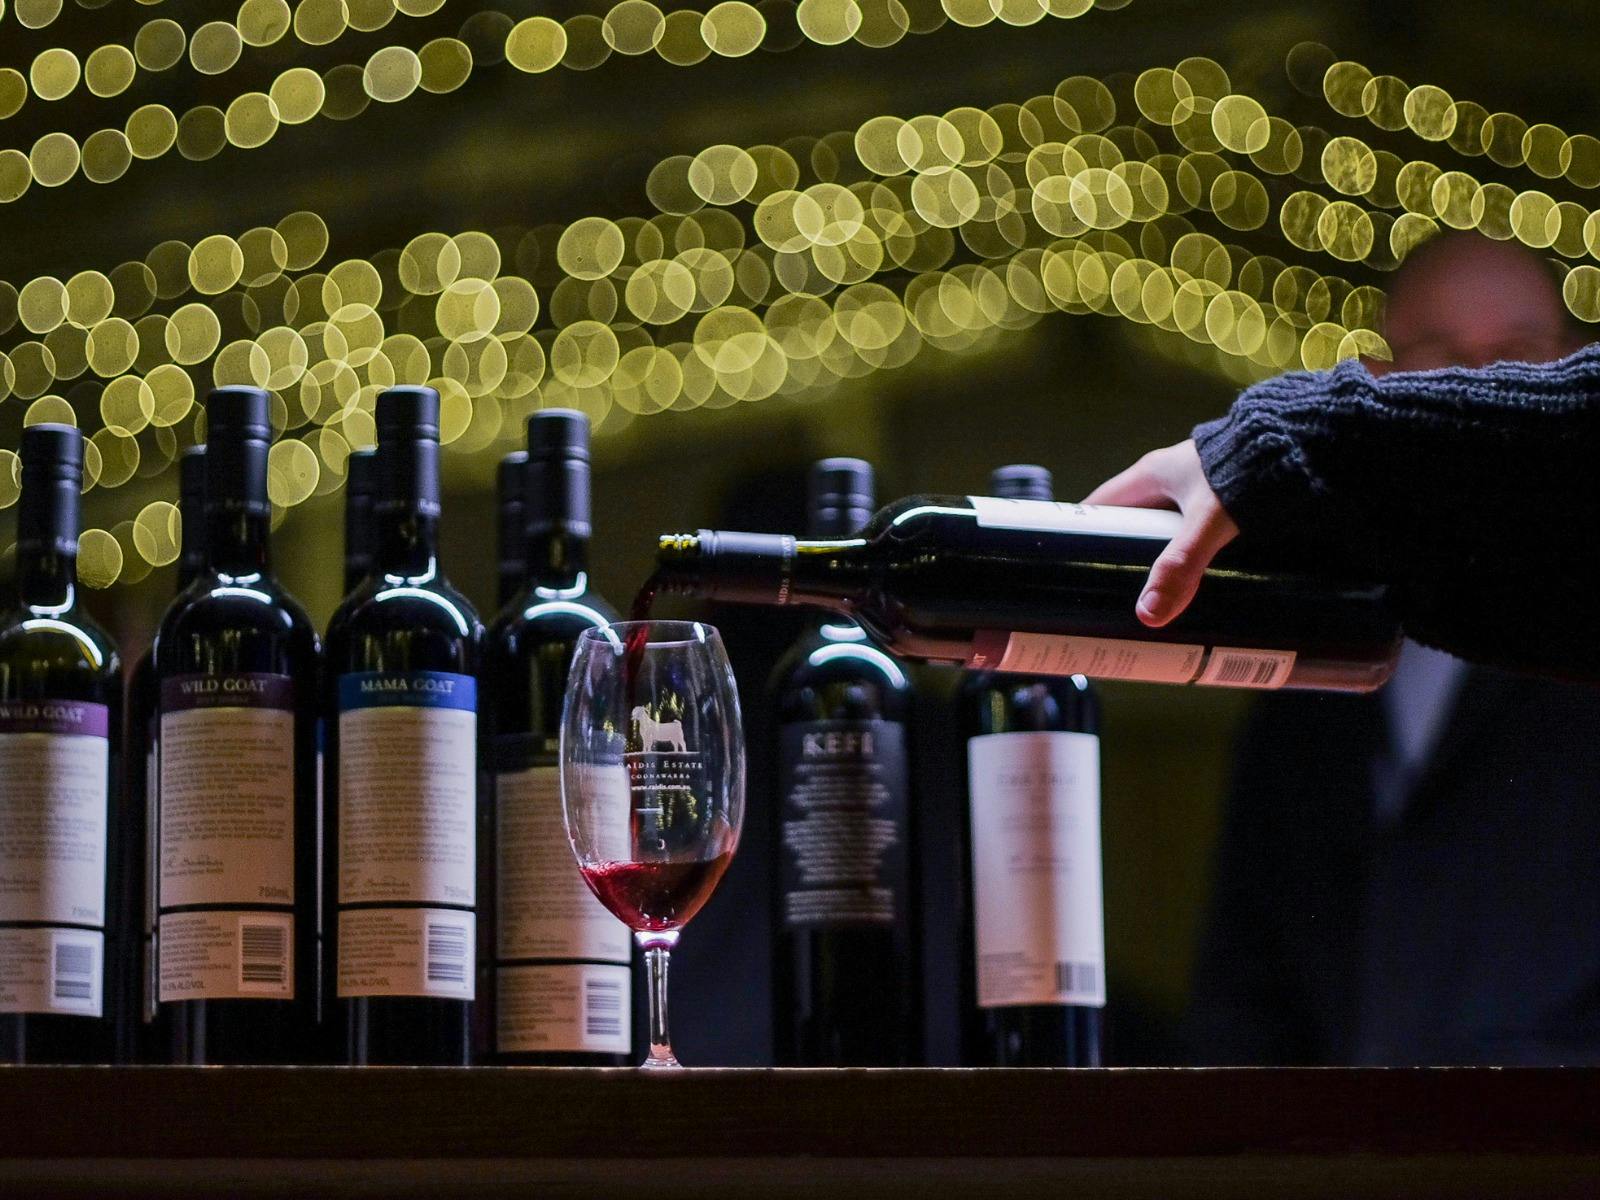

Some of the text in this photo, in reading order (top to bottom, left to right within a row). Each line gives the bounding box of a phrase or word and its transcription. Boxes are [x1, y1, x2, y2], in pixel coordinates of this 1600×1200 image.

[180, 678, 266, 694] WILD GOAT
[361, 679, 455, 694] MAMA GOAT
[43, 706, 84, 722] GOAT
[663, 760, 703, 769] ESTATE
